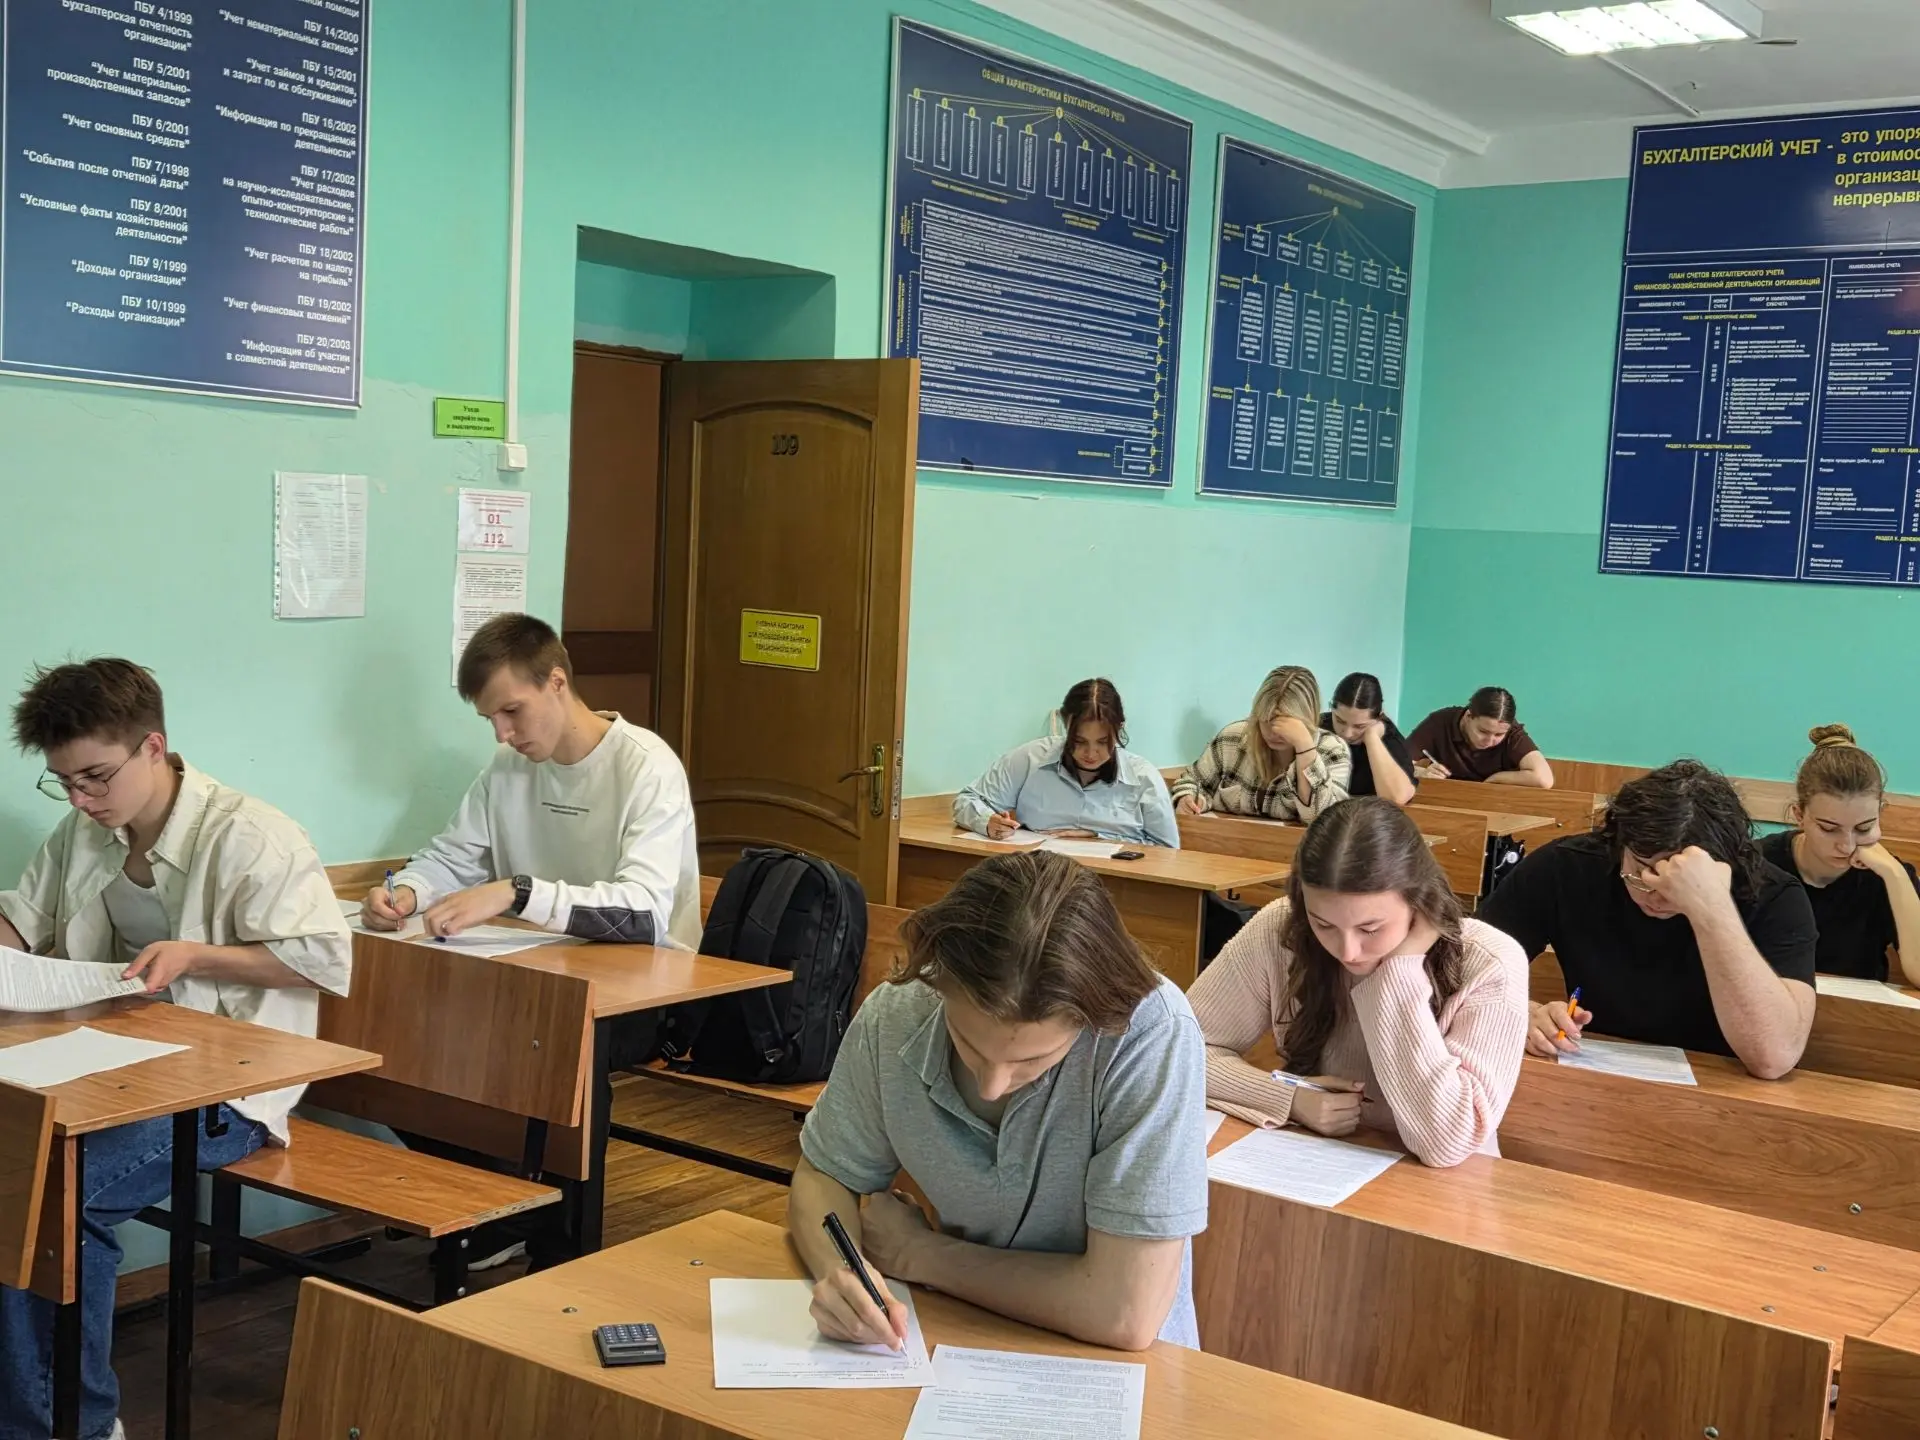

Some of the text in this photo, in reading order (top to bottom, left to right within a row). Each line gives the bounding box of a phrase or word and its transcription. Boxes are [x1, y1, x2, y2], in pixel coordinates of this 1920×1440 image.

[134, 0, 193, 25] ПБУ 4/1999
[139, 18, 193, 39] отчетность
[246, 18, 320, 47] нематериальных
[304, 20, 359, 44] ПБУ 14/2000
[133, 57, 190, 80] ПБУ 5/2001
[274, 67, 305, 82] займов
[307, 76, 314, 85] и
[302, 59, 357, 82] ПБУ 15/2001
[47, 68, 144, 98] производственных
[122, 71, 191, 94] материально-
[223, 68, 230, 76] и
[232, 70, 262, 84] затрат
[264, 78, 276, 88] по
[278, 82, 289, 92] их
[94, 122, 144, 140] основных
[132, 113, 190, 135] ПБУ 6/2001
[280, 122, 292, 132] по
[302, 112, 357, 135] ПБУ 16/2002
[1642, 139, 1774, 165] БУХГАЛТЕРСКИЙ
[1780, 139, 1822, 156] УЧЕТ
[1841, 130, 1870, 144] это
[132, 156, 190, 178] ПБУ 7/1998
[1836, 153, 1846, 164] в
[78, 161, 109, 176] после
[112, 169, 157, 186] отчетной
[222, 177, 234, 187] на
[300, 164, 356, 186] ПБУ 17/2002
[316, 184, 356, 198] расходов
[80, 204, 113, 219] факты
[116, 211, 188, 232] хозяйственной
[130, 198, 188, 218] ПБУ 8/2001
[244, 208, 317, 230] технологические
[348, 216, 354, 224] и
[299, 243, 354, 262] ПБУ 18/2002
[130, 254, 188, 274] ПБУ 9/1999
[272, 253, 310, 267] расчетов
[312, 261, 324, 270] по
[325, 264, 354, 277] налогу
[299, 271, 310, 280] на
[122, 295, 186, 314] ПБУ 10/1999
[251, 301, 304, 318] финансовых
[298, 295, 352, 312] ПБУ 19/2002
[297, 333, 351, 350] ПБУ 20/2003
[235, 354, 286, 368] совместной
[305, 348, 316, 358] об
[488, 514, 500, 524] 01
[484, 533, 504, 544] 112
